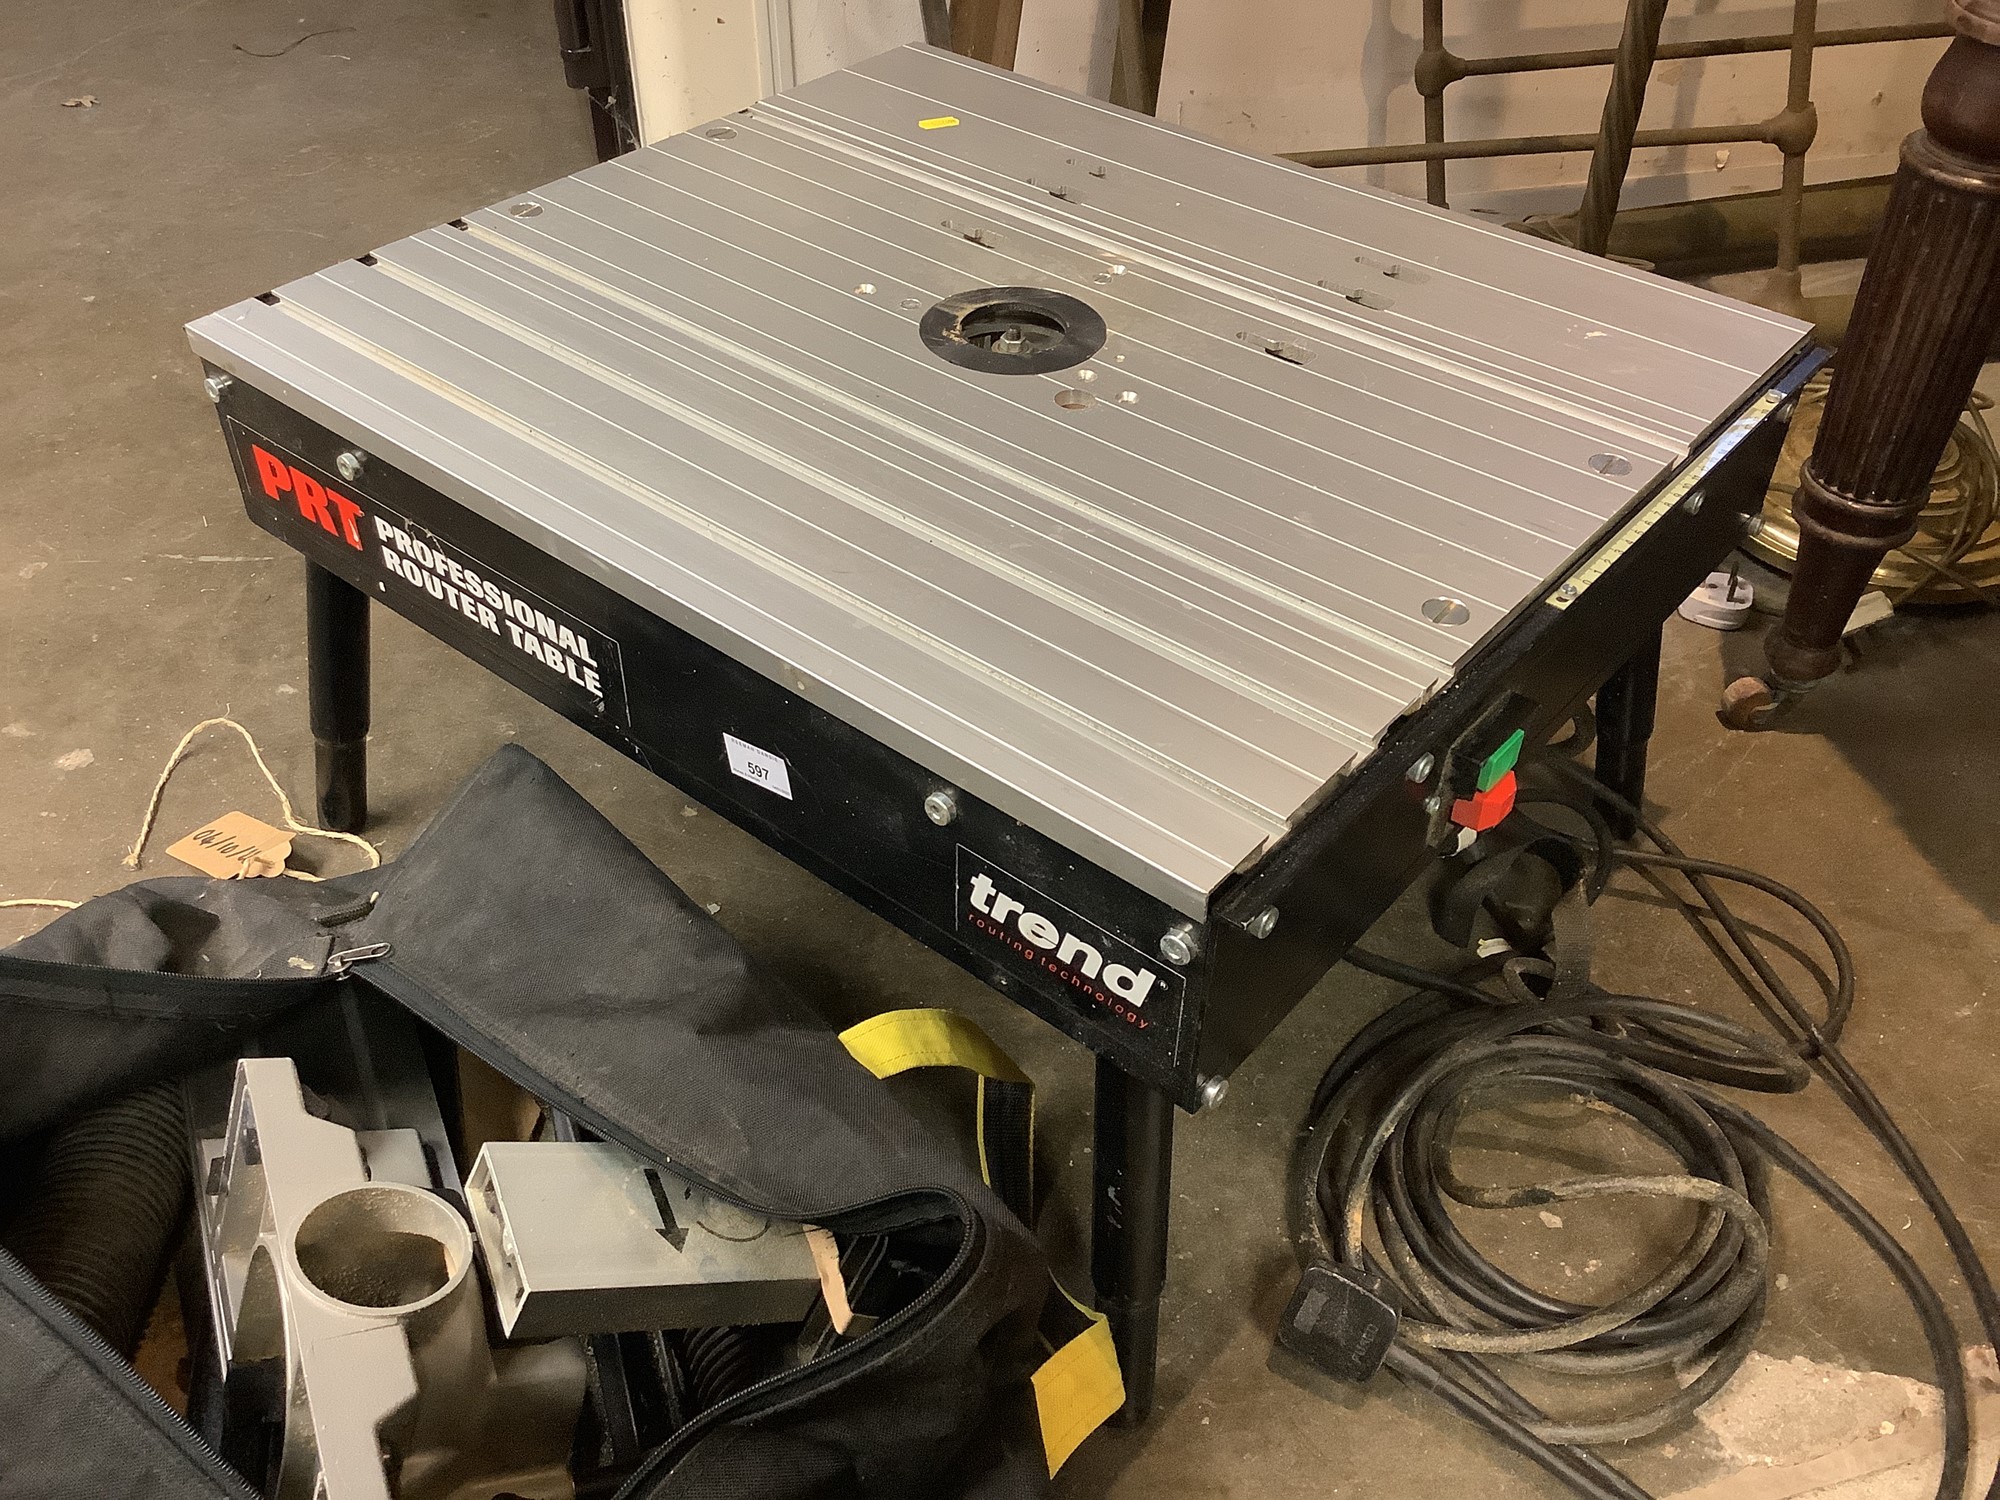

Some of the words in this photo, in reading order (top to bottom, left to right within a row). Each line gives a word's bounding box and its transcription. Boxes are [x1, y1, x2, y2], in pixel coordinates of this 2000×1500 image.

[251, 443, 365, 551] PRT
[373, 514, 598, 667] PROFESSIONAL
[381, 545, 501, 635] ROUTER
[505, 619, 603, 697] TABLE
[747, 761, 769, 780] 597
[968, 913, 1034, 960] routing
[1041, 957, 1149, 1029] technology
[969, 872, 1157, 1008] trend
